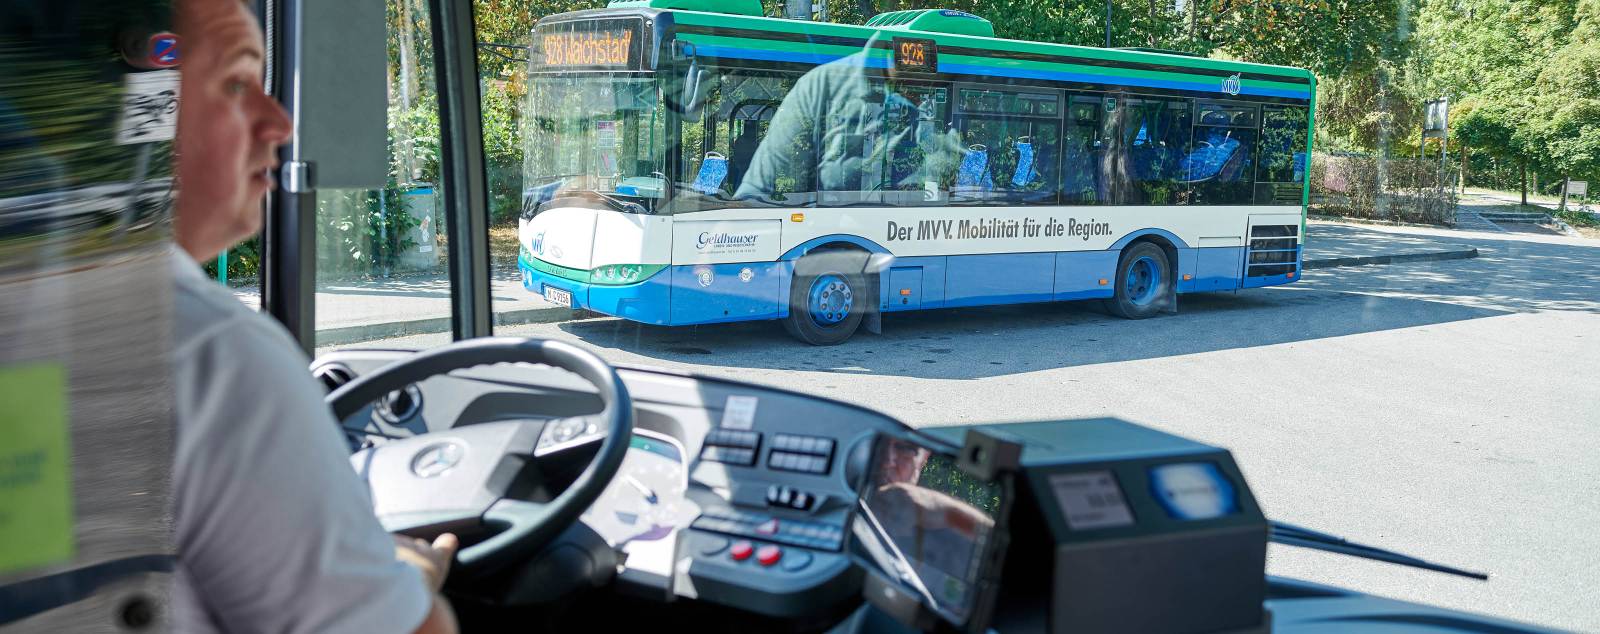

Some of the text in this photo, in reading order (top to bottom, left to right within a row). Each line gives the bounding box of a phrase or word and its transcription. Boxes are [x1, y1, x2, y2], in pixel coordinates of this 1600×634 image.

[544, 34, 563, 65] 928
[901, 42, 925, 65] 928
[696, 231, 759, 249] Geldhauser
[887, 216, 1113, 241] Der MVV. Mobilität für die Region.
